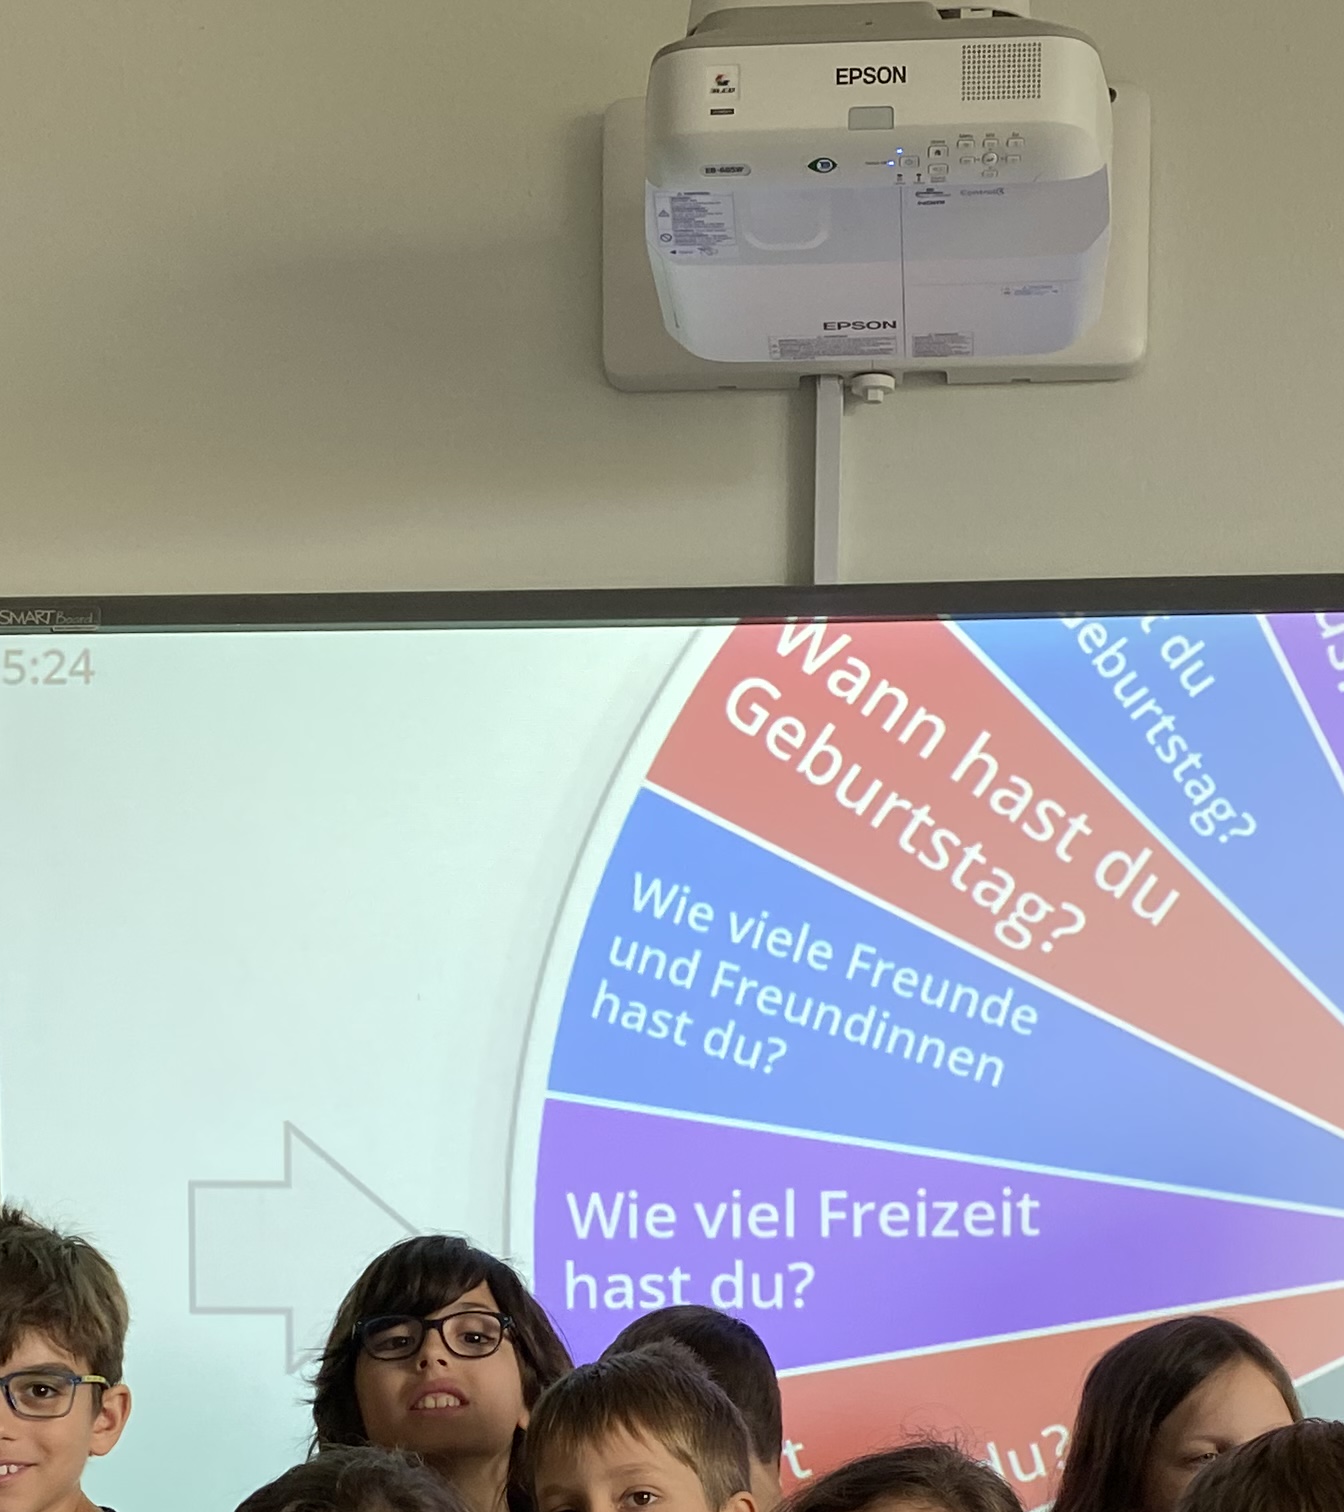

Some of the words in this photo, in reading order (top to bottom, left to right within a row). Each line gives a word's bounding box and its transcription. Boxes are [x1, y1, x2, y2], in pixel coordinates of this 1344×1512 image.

[835, 66, 907, 85] EPSON
[823, 320, 897, 330] EPSON
[3, 648, 95, 685] 5:24
[1161, 634, 1215, 697] du
[776, 615, 946, 759] Wann
[951, 730, 1093, 863] hast
[1093, 847, 1180, 926] du
[724, 676, 1087, 953] Geburtstag?
[632, 873, 715, 934] Wie
[728, 910, 834, 971] viele
[846, 943, 1040, 1036] Freunde
[591, 979, 694, 1047] hast
[703, 1021, 788, 1075] du?
[609, 936, 701, 990] und
[710, 962, 1006, 1088] Freundinnen
[566, 1190, 677, 1240] Wie
[694, 1187, 795, 1239] viel
[820, 1187, 1041, 1238] Freizeit
[564, 1259, 692, 1310] hast
[710, 1259, 815, 1310] du?
